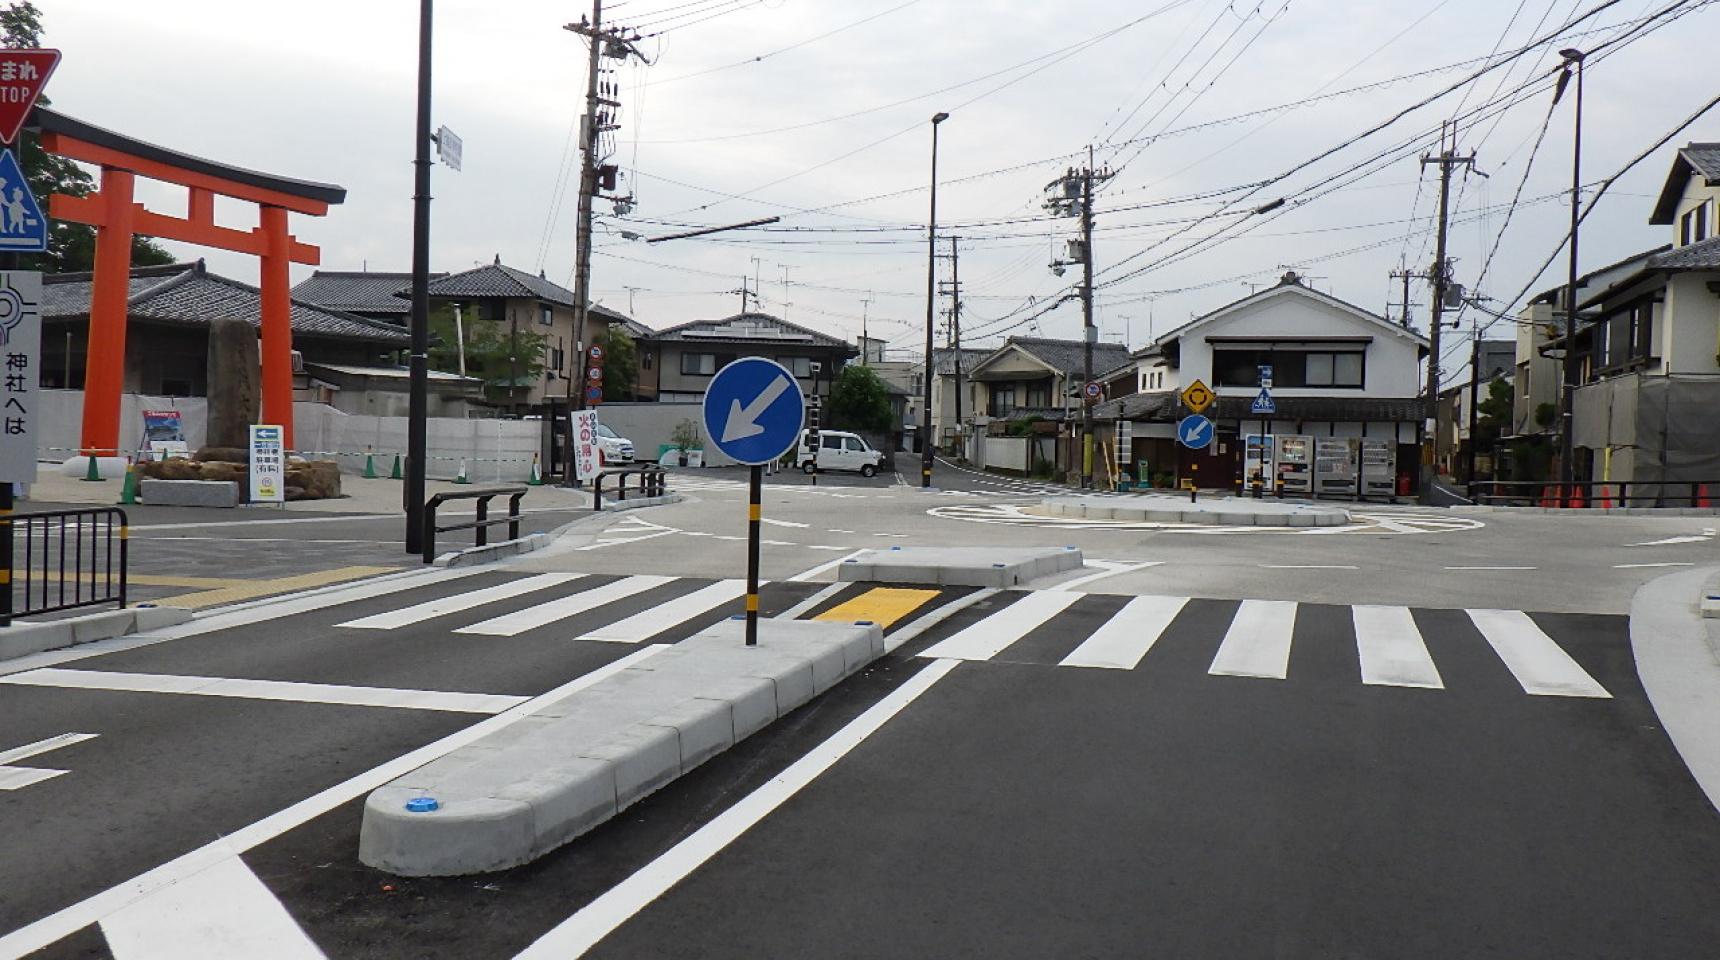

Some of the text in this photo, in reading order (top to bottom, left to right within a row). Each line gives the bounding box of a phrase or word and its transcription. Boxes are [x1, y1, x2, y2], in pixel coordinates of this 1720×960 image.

[0, 87, 30, 103] TOP
[5, 352, 27, 435] 神社へは
